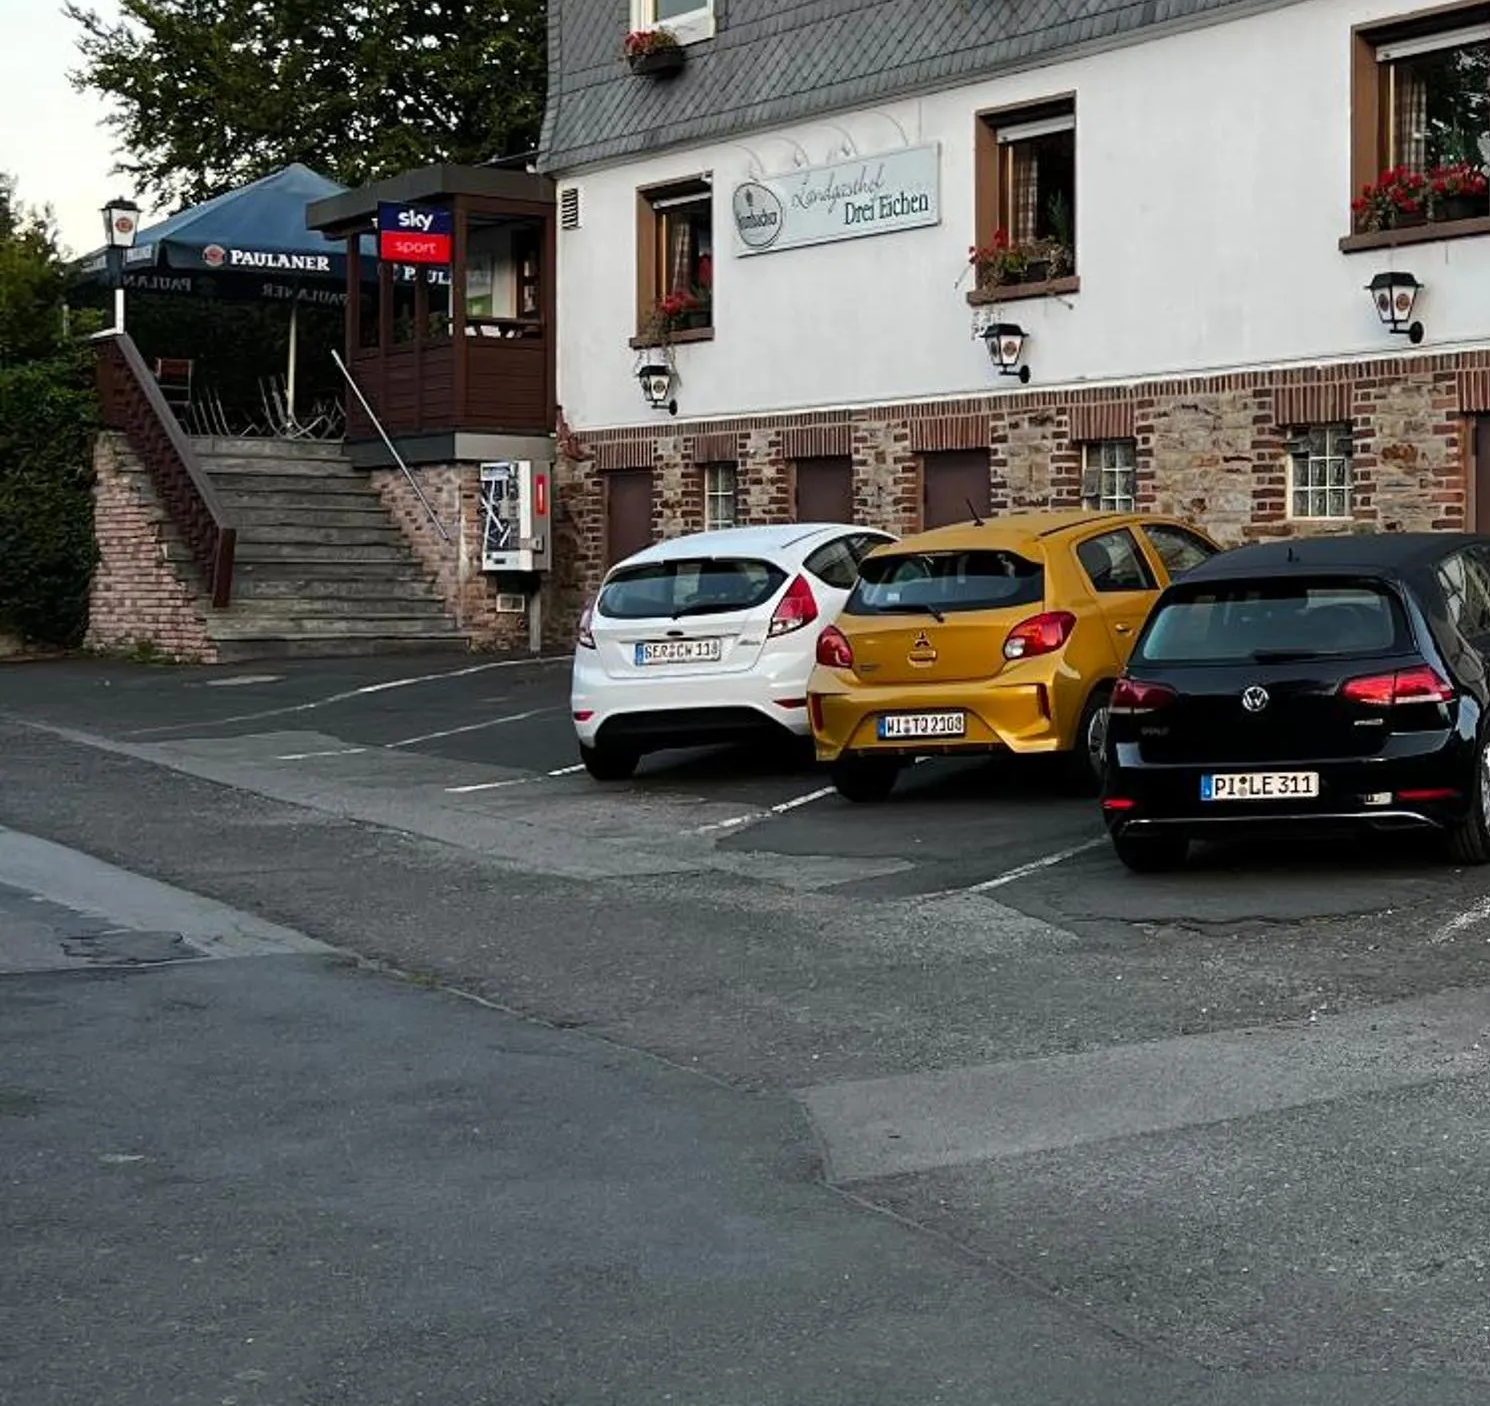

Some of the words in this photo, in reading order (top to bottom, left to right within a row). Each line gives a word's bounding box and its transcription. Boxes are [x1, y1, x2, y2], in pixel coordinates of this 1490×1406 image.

[844, 199, 875, 226] Drei
[879, 190, 930, 220] Eichen
[398, 209, 434, 231] sky
[394, 241, 438, 255] sport
[230, 249, 331, 272] PAULANER
[1214, 777, 1236, 795] PI
[1250, 776, 1274, 794] LE
[1277, 775, 1313, 793] 311
